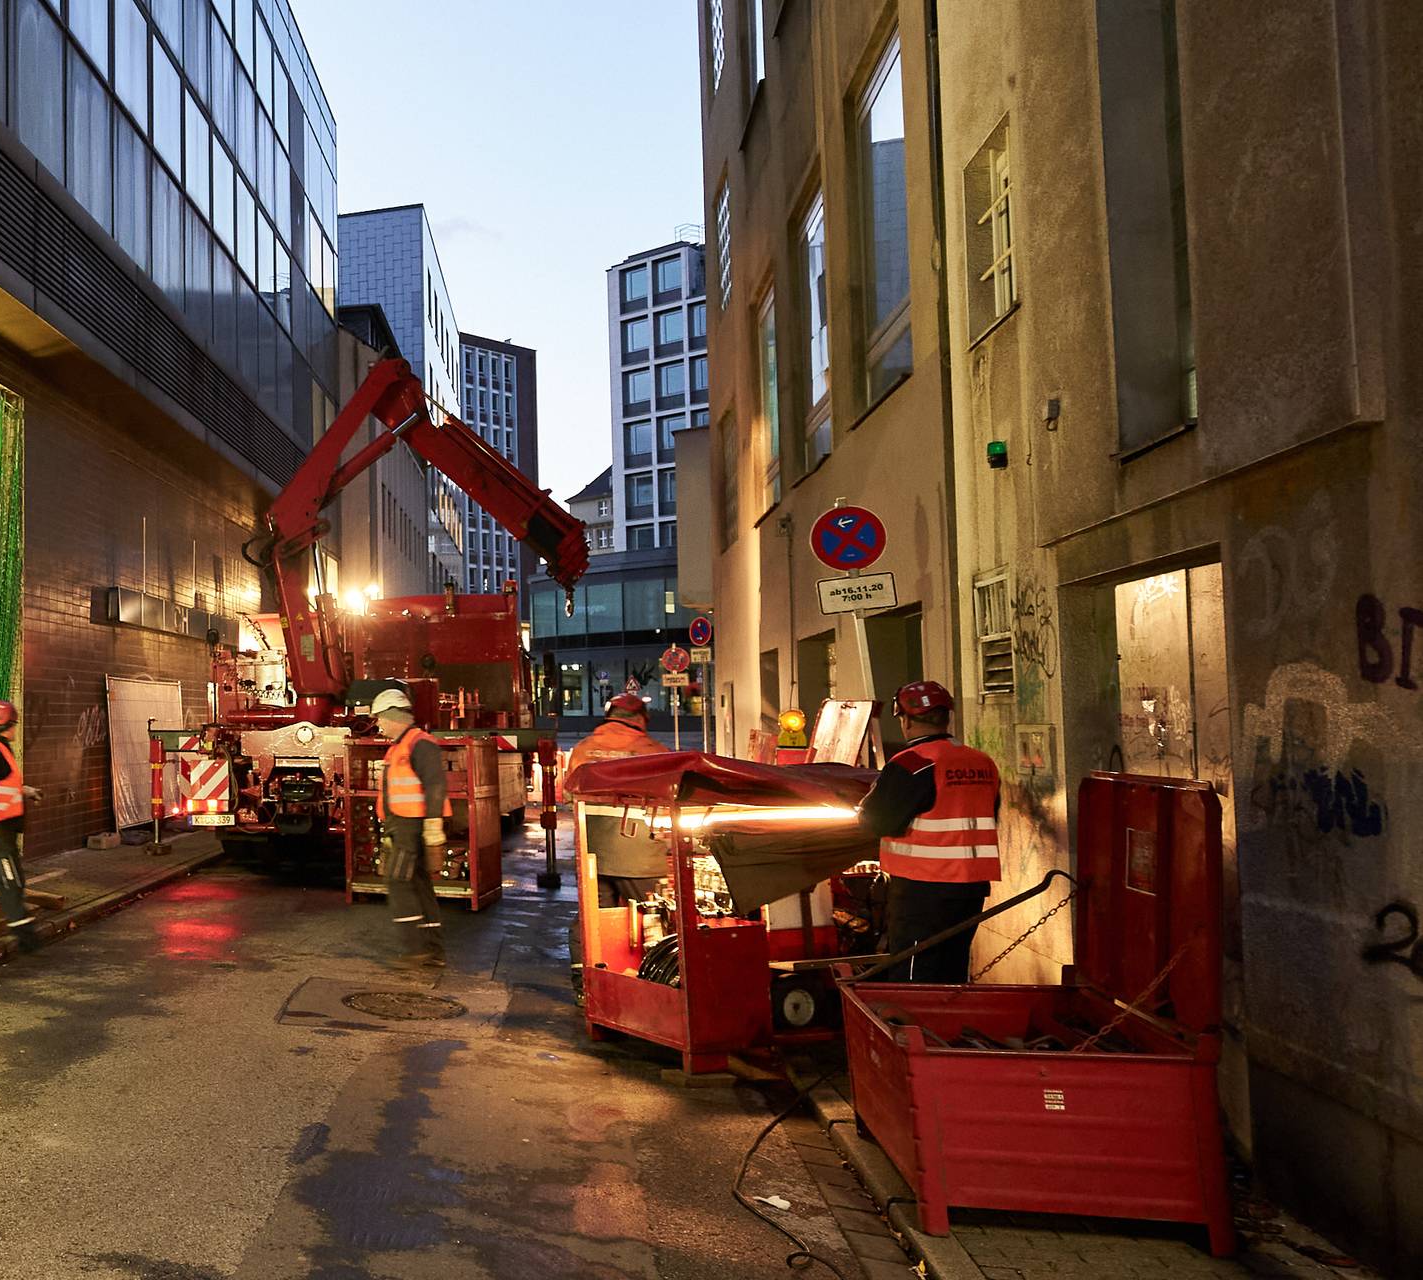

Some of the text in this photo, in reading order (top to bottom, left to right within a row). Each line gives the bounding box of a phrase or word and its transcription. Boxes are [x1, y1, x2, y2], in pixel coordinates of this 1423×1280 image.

[830, 583, 884, 597] ab16.11.20
[842, 592, 873, 602] 7:00 h
